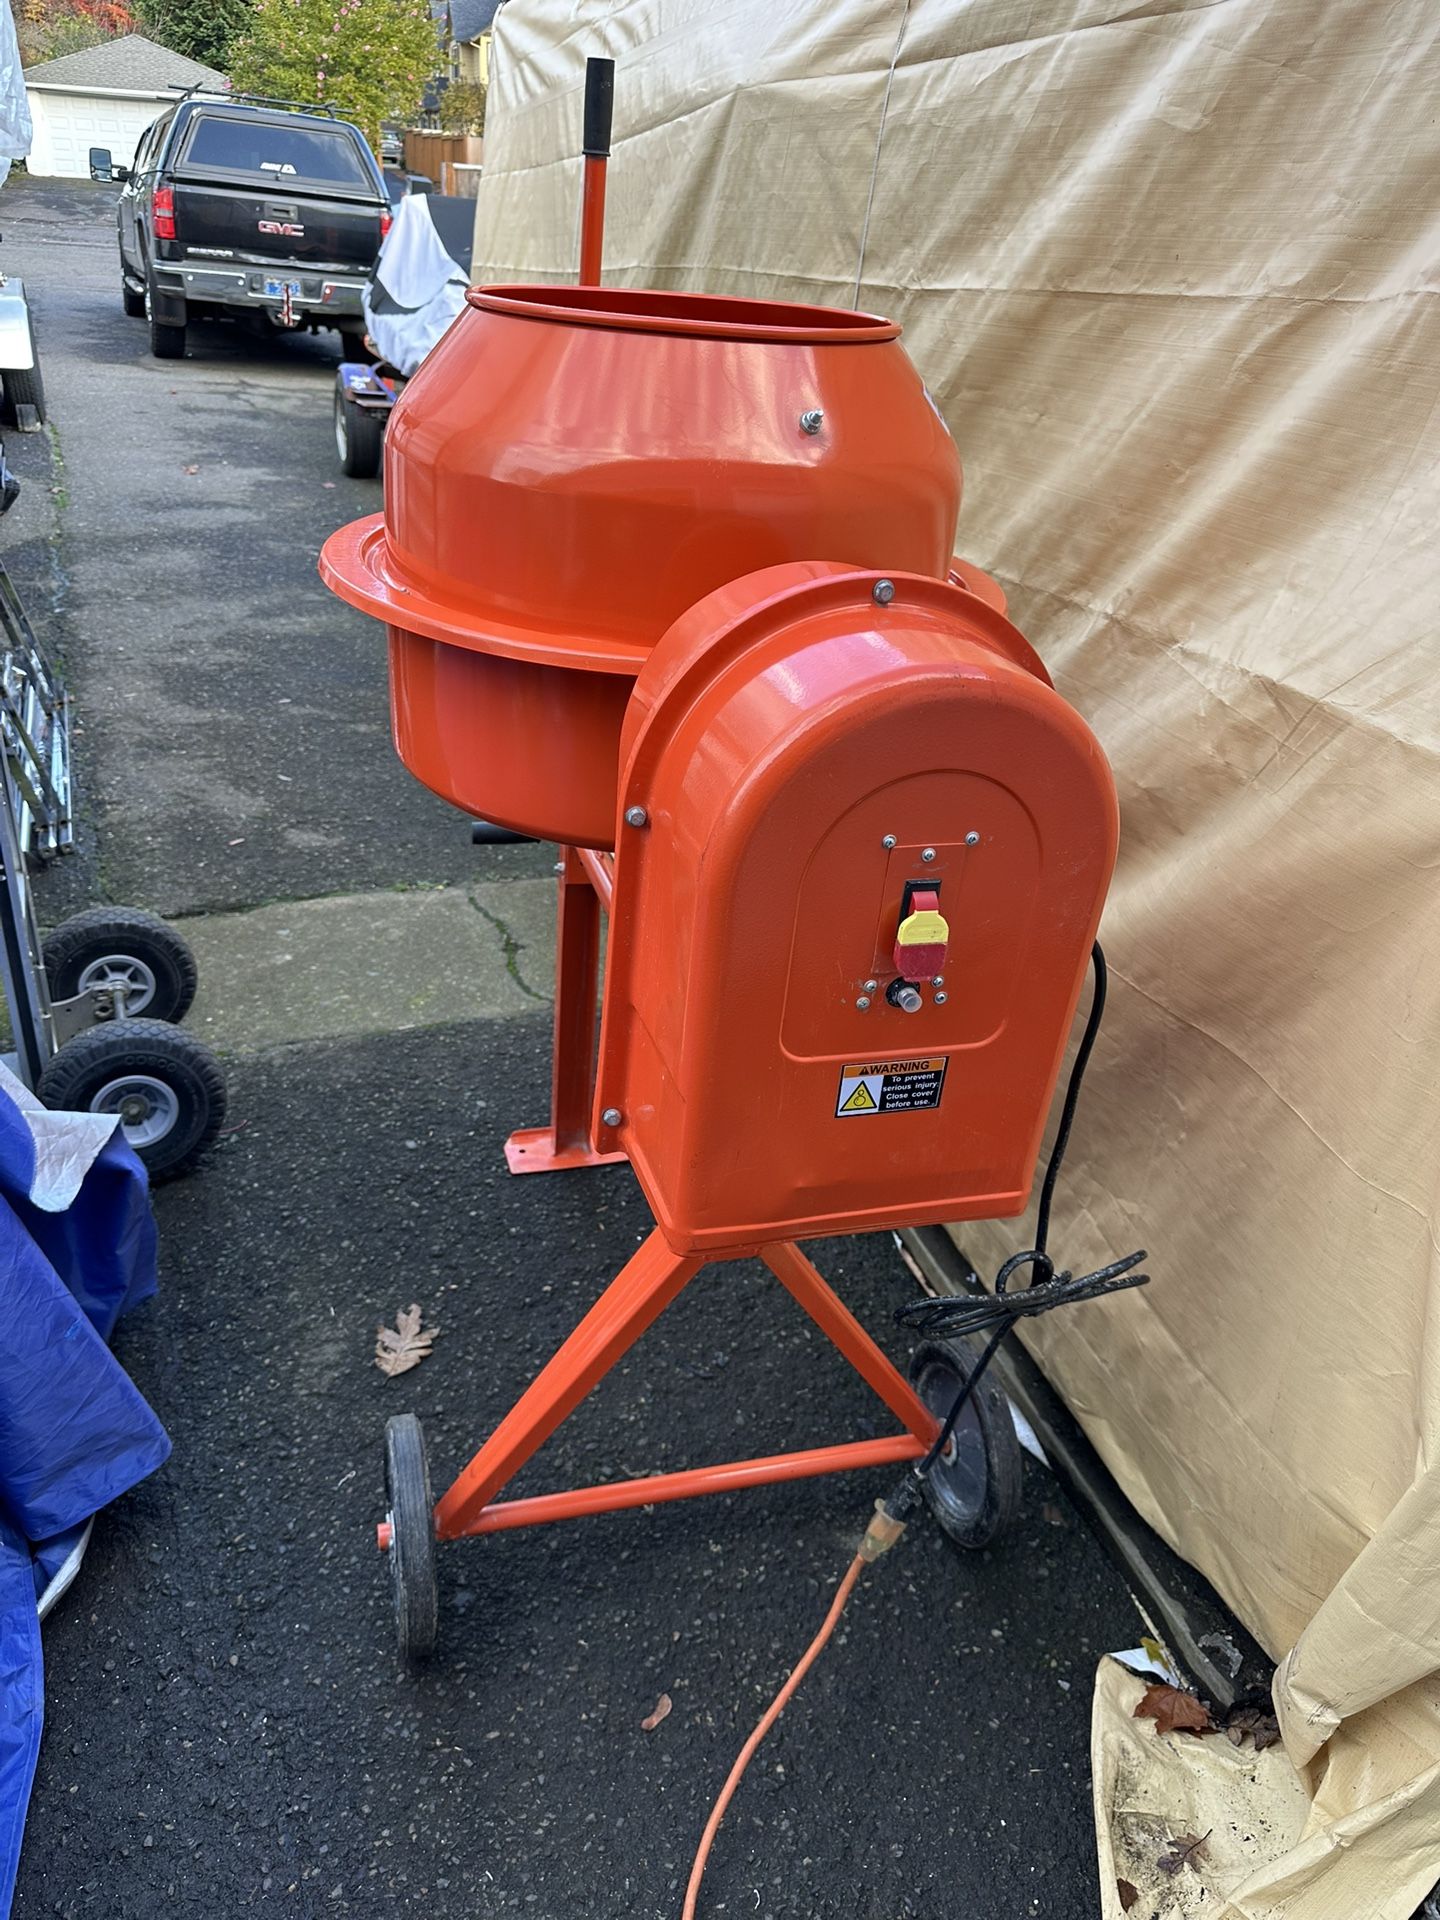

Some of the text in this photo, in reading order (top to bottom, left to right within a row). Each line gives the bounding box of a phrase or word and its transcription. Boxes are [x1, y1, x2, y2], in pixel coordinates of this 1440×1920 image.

[258, 220, 305, 237] GMC
[869, 1061, 930, 1075] WARNING
[904, 1073, 935, 1083] prevent
[883, 1084, 912, 1092] serious
[886, 1090, 934, 1101] Close cover
[885, 1098, 931, 1109] before use.
